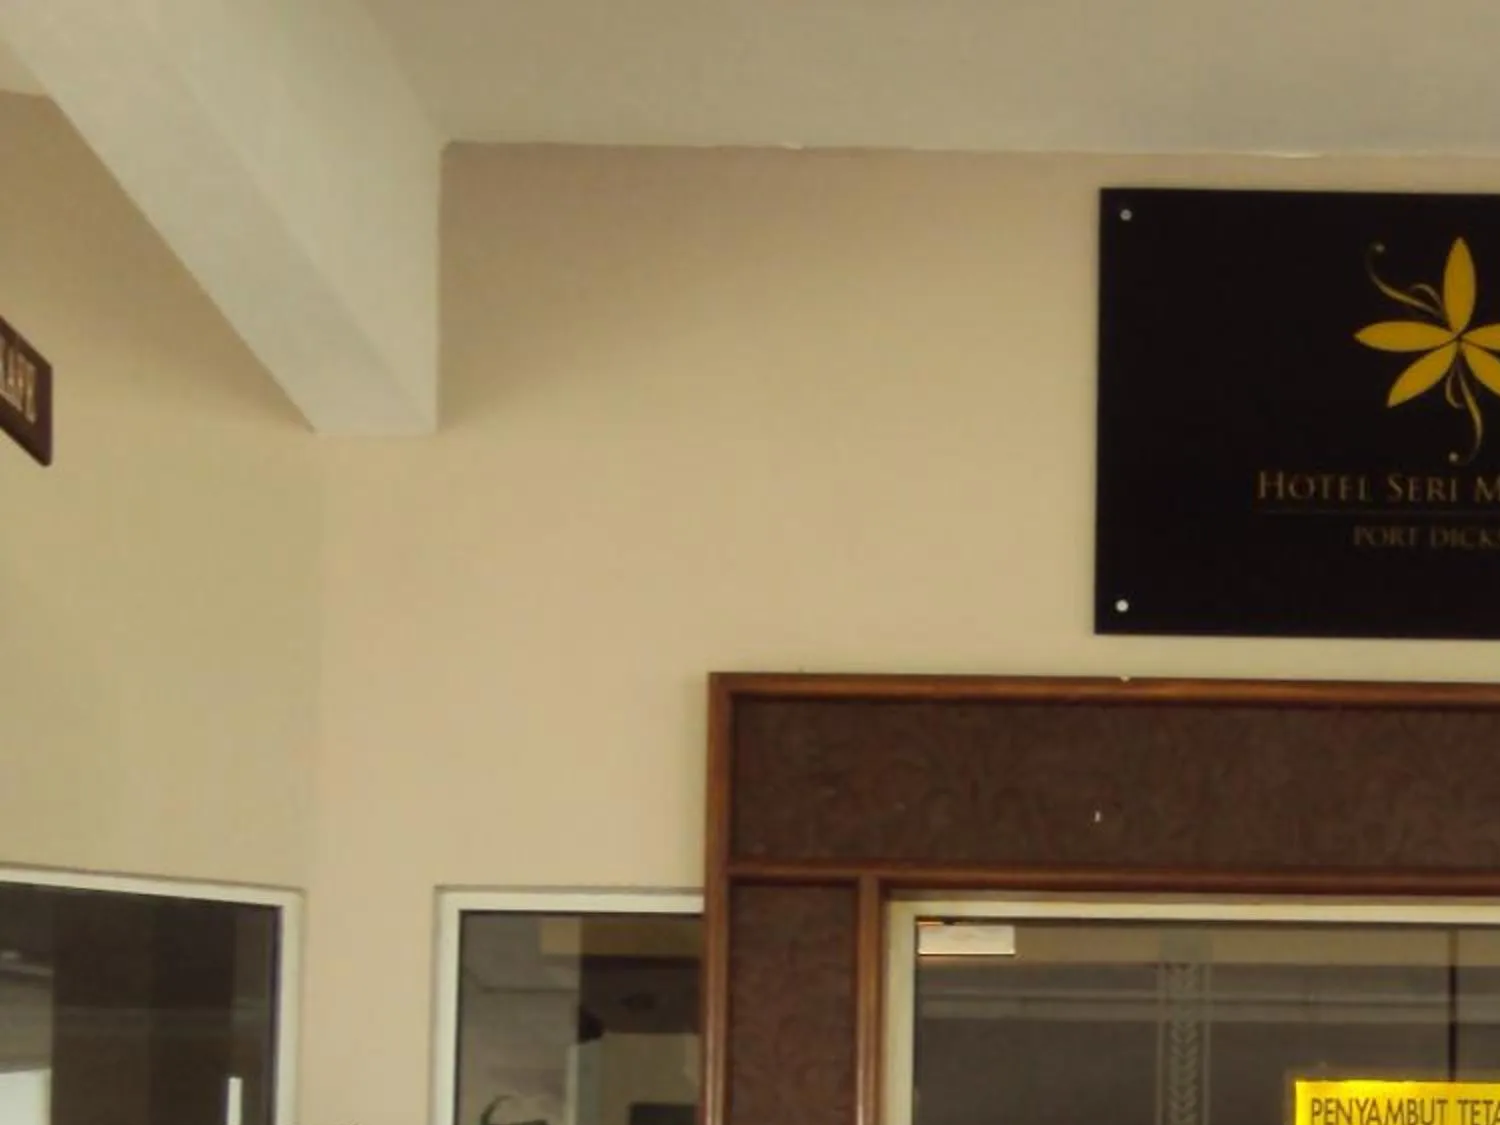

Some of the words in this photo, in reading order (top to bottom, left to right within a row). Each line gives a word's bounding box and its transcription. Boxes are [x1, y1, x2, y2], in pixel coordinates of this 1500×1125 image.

[1257, 470, 1371, 501] HOTEL
[1387, 473, 1459, 503] SERI
[1352, 525, 1417, 547] PORT
